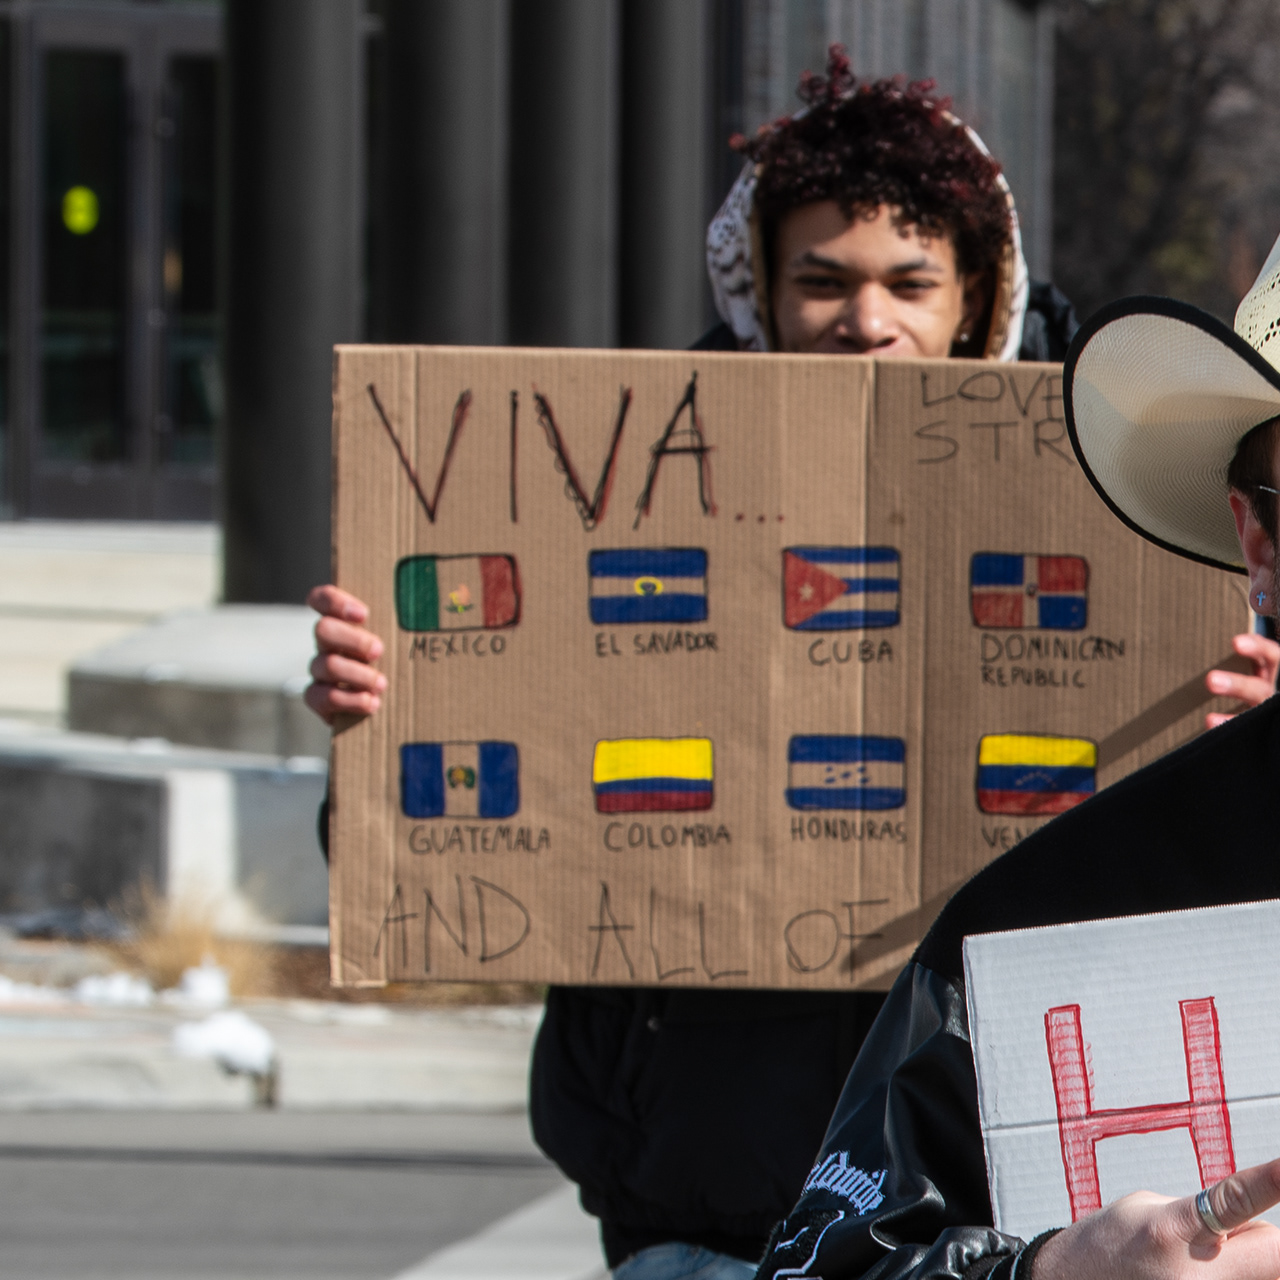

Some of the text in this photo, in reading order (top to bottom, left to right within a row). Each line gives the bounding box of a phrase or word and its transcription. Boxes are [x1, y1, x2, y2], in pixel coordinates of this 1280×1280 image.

[408, 633, 507, 662] MEXICO
[595, 630, 720, 657] EL SAVADOR
[807, 637, 894, 666] CUBA
[980, 632, 1126, 662] DOMINICAN
[980, 666, 1086, 688] REPUBLIC
[408, 824, 551, 855] GUATEMALA
[603, 821, 732, 850] COLOMBIA
[790, 816, 908, 843] HONDURAS
[373, 873, 890, 981] AND ALL OF
